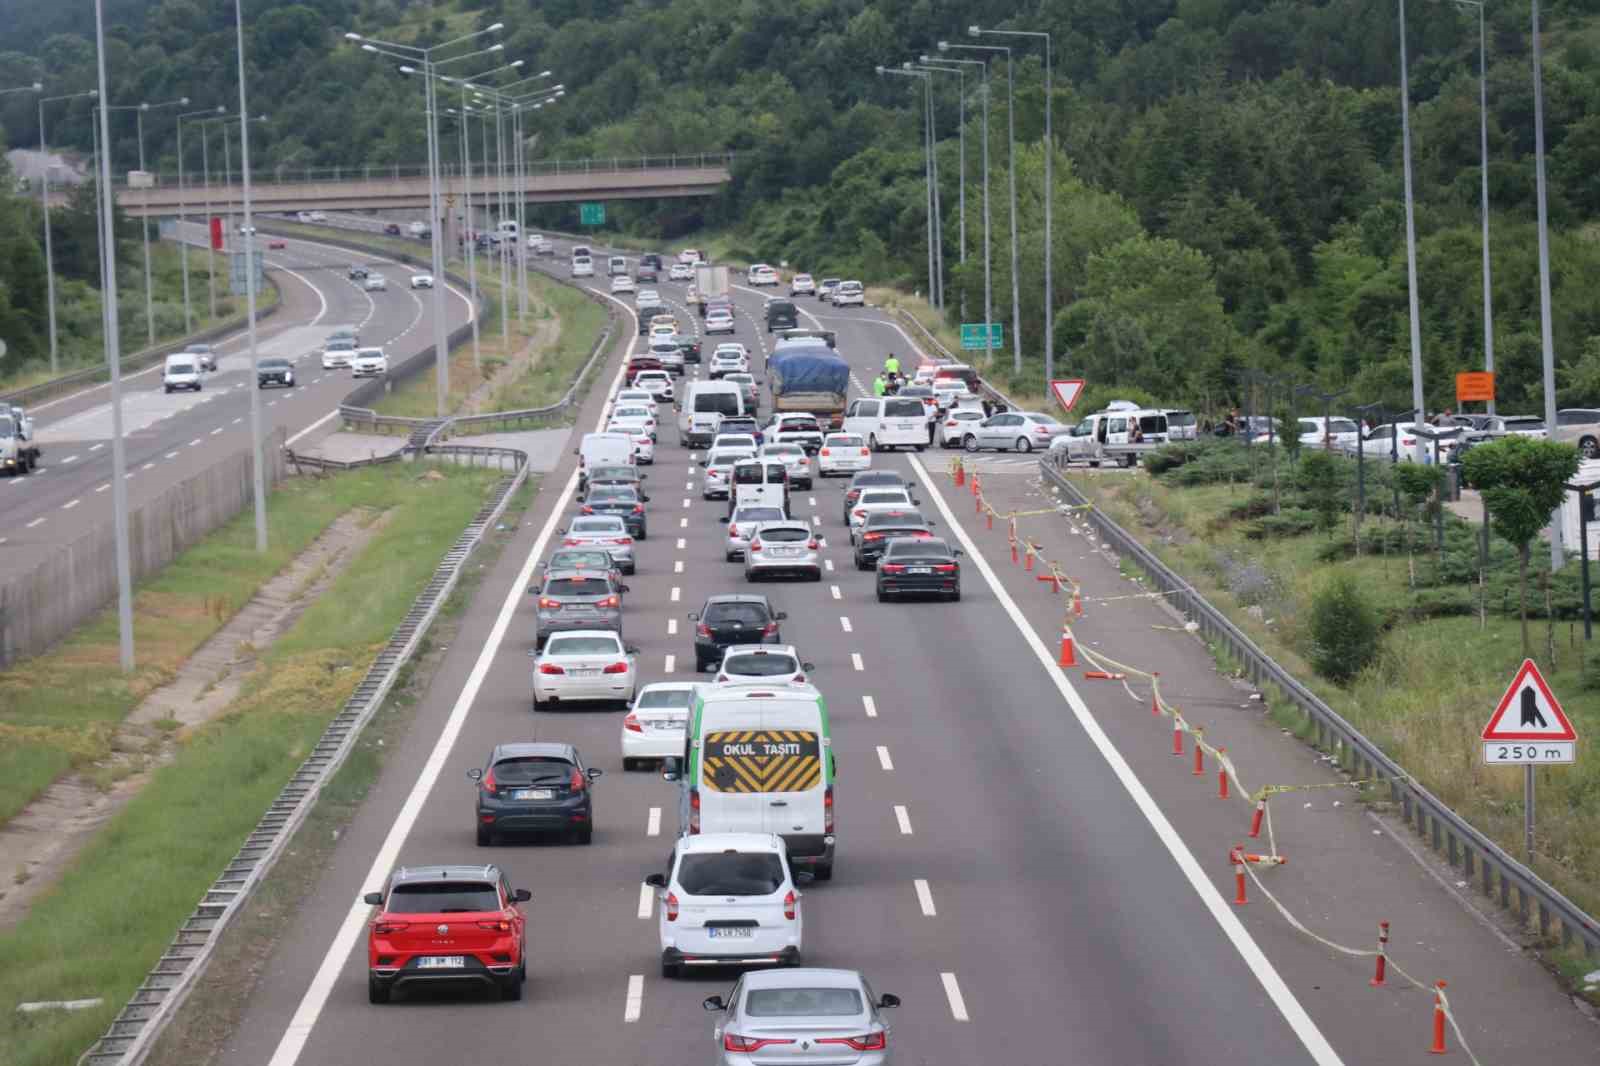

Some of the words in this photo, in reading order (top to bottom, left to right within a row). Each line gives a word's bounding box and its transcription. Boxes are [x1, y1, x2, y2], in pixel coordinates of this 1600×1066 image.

[723, 744, 756, 755] OKUL
[763, 743, 800, 757] TAŞITI
[1498, 746, 1537, 759] 250
[1544, 749, 1561, 759] m
